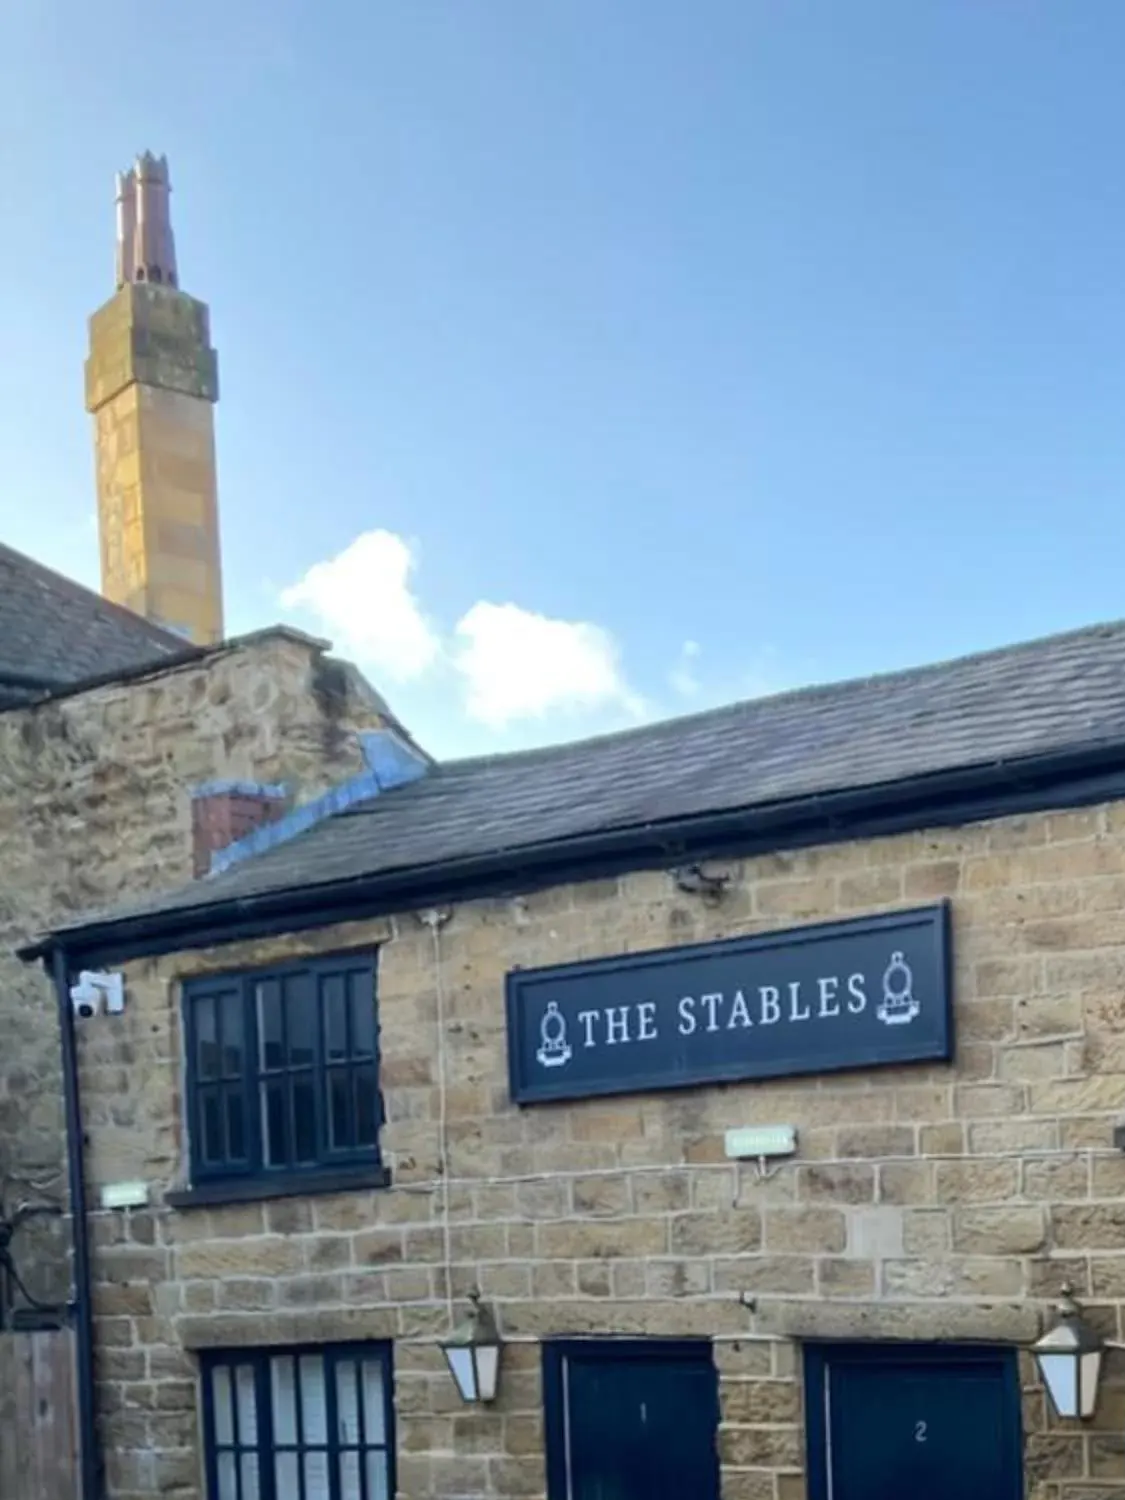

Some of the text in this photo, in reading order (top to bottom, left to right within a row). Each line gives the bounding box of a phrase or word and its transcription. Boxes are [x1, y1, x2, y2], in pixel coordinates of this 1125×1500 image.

[578, 973, 867, 1047] THE STABLES
[639, 1401, 647, 1424] 1
[914, 1420, 928, 1442] 2
